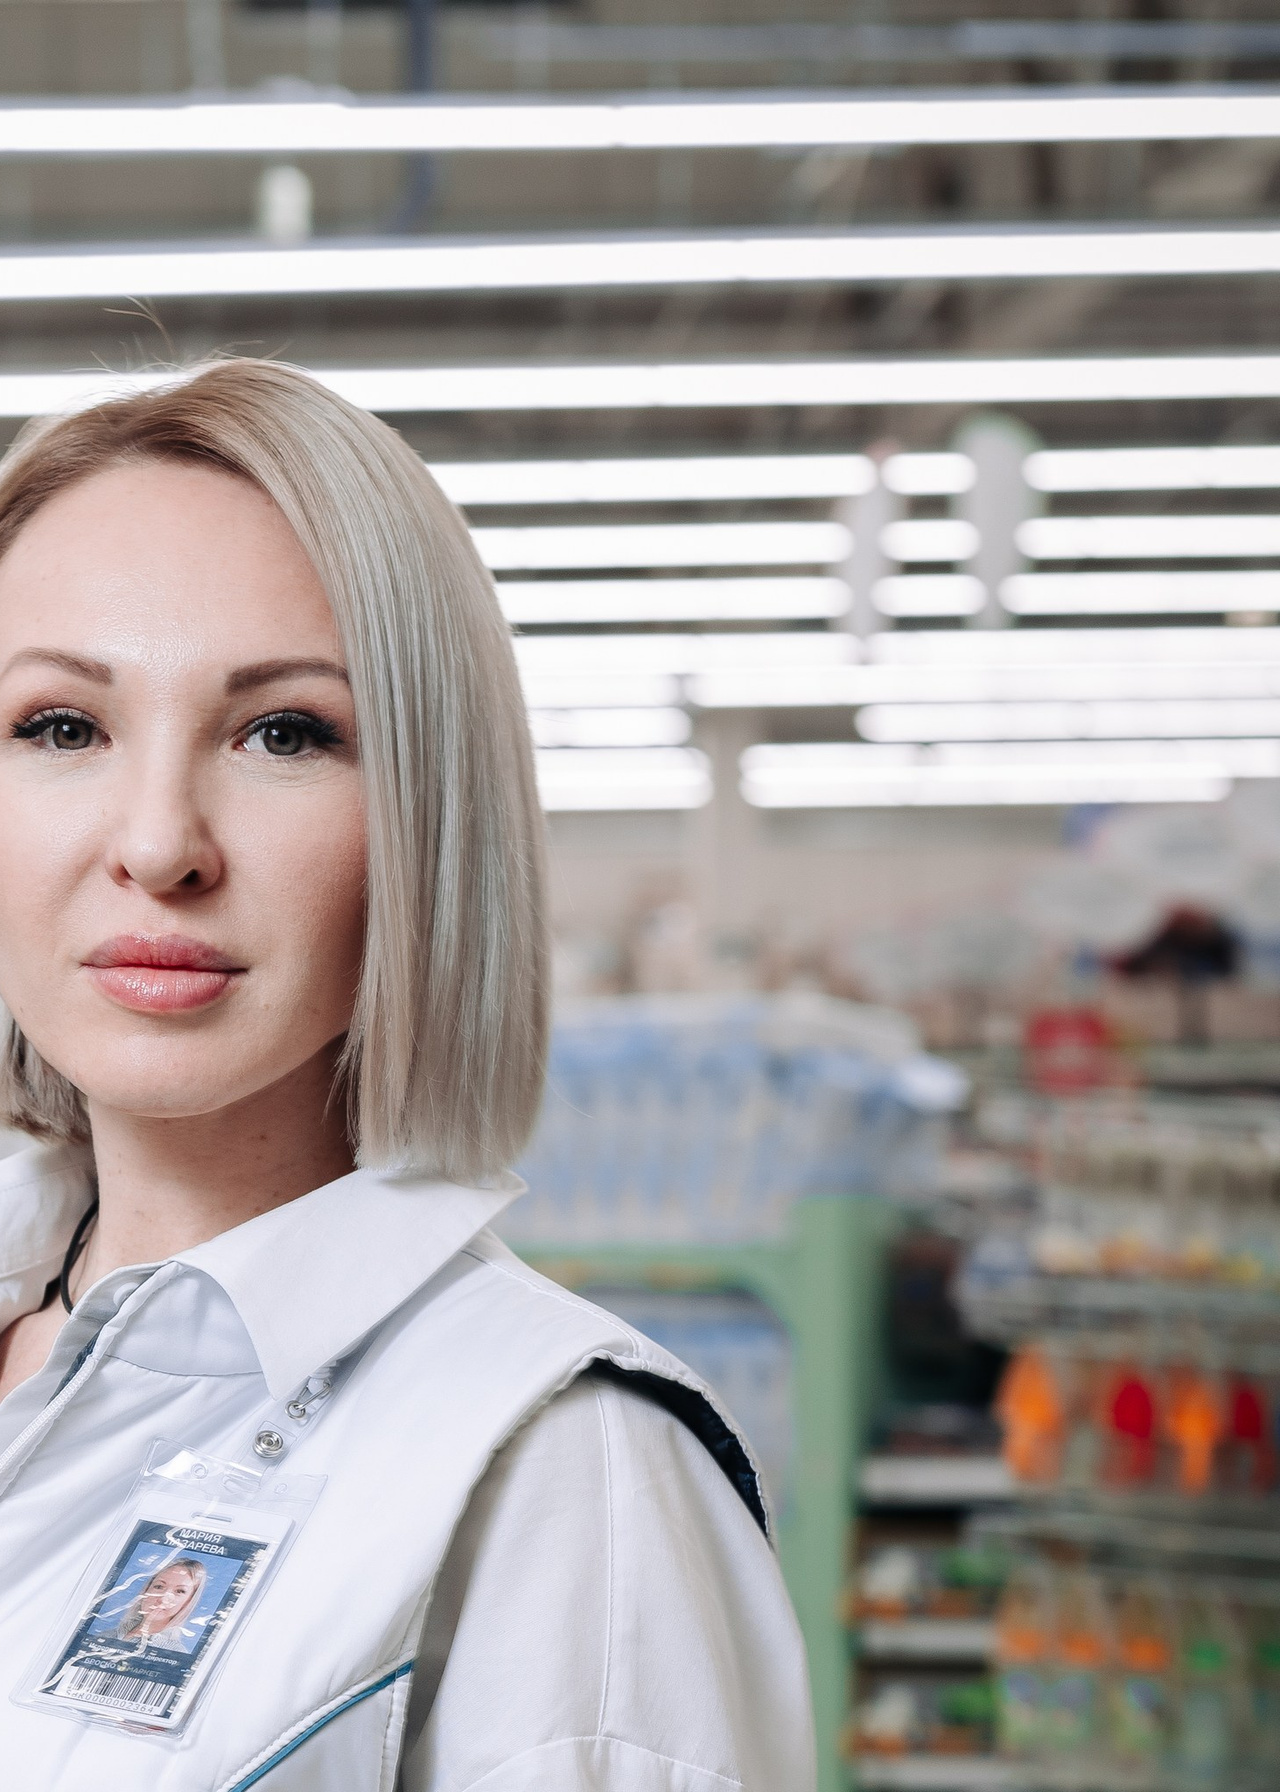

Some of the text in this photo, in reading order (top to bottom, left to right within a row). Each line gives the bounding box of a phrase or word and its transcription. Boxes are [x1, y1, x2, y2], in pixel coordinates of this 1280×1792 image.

[179, 1528, 222, 1543] МАРИЯ
[164, 1538, 225, 1556] ЛАЗАРЕВА
[145, 1654, 178, 1665] директор
[126, 1666, 161, 1678] МАРКЕТ
